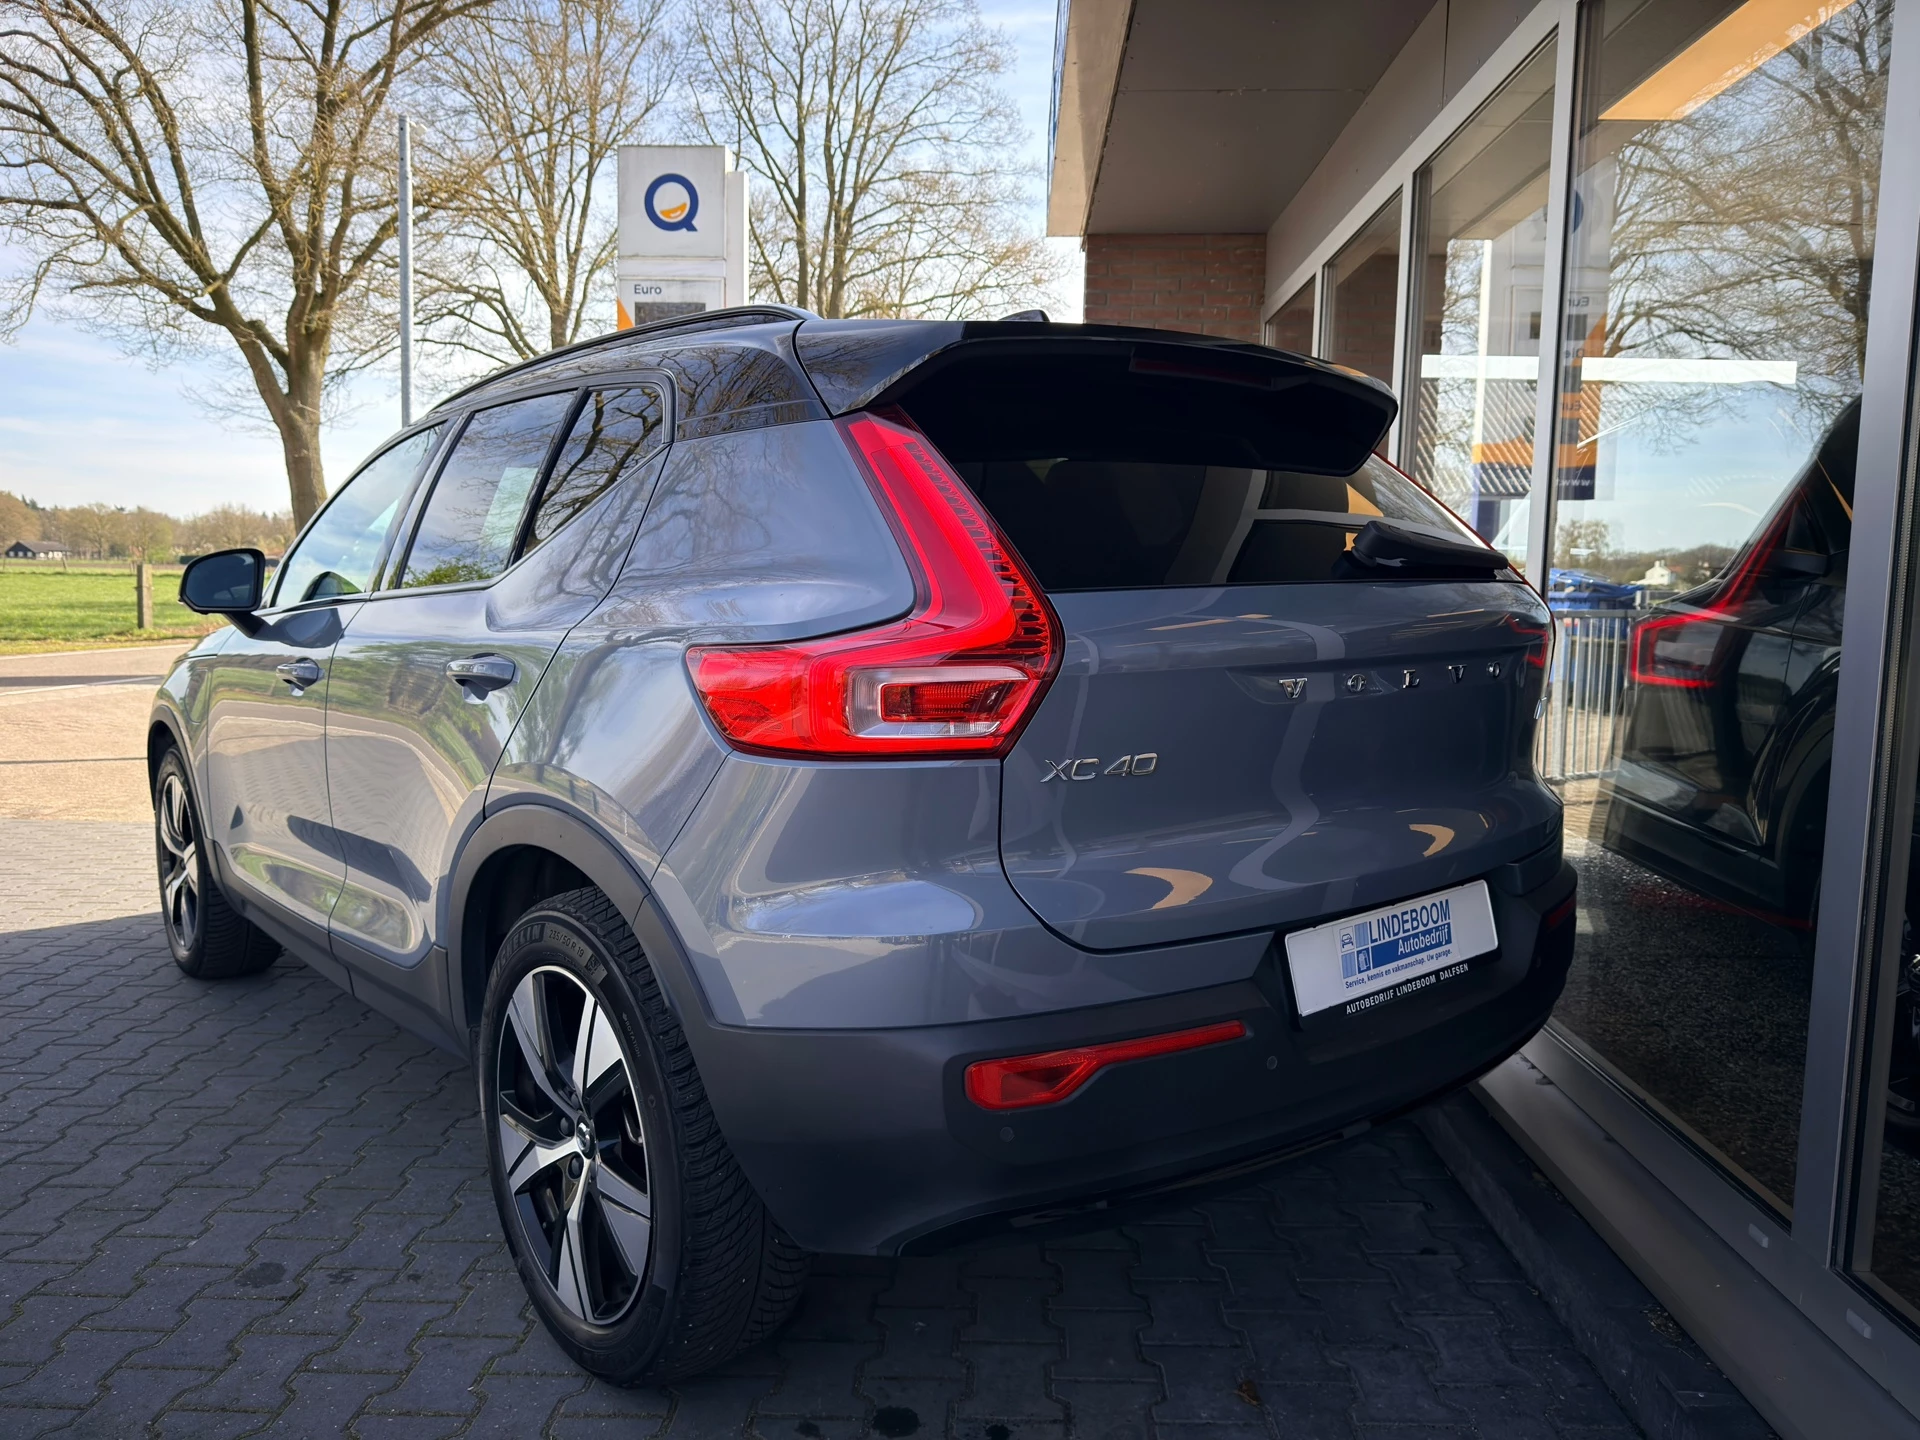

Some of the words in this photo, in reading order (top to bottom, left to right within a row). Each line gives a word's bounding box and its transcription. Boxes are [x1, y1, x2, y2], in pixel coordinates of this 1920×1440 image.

[634, 284, 662, 295] Euro
[1278, 660, 1501, 699] VOLVO
[1369, 899, 1451, 944] LINDEBOOM
[1398, 926, 1449, 955] Autobedrijf
[549, 930, 571, 946] 235/50
[577, 946, 585, 958] 19
[1345, 975, 1367, 989] Service,
[1367, 970, 1384, 981] kennis
[1384, 968, 1392, 976] en
[1391, 958, 1426, 973] vakmanschap.
[1426, 953, 1435, 962] Uw
[1435, 948, 1453, 960] garage.
[1346, 989, 1395, 1015] AUTOBEDRIJF
[1396, 974, 1437, 997] LINDEBOOM
[1439, 963, 1469, 980] DALFSEN
[625, 1020, 642, 1058] ROTATION
